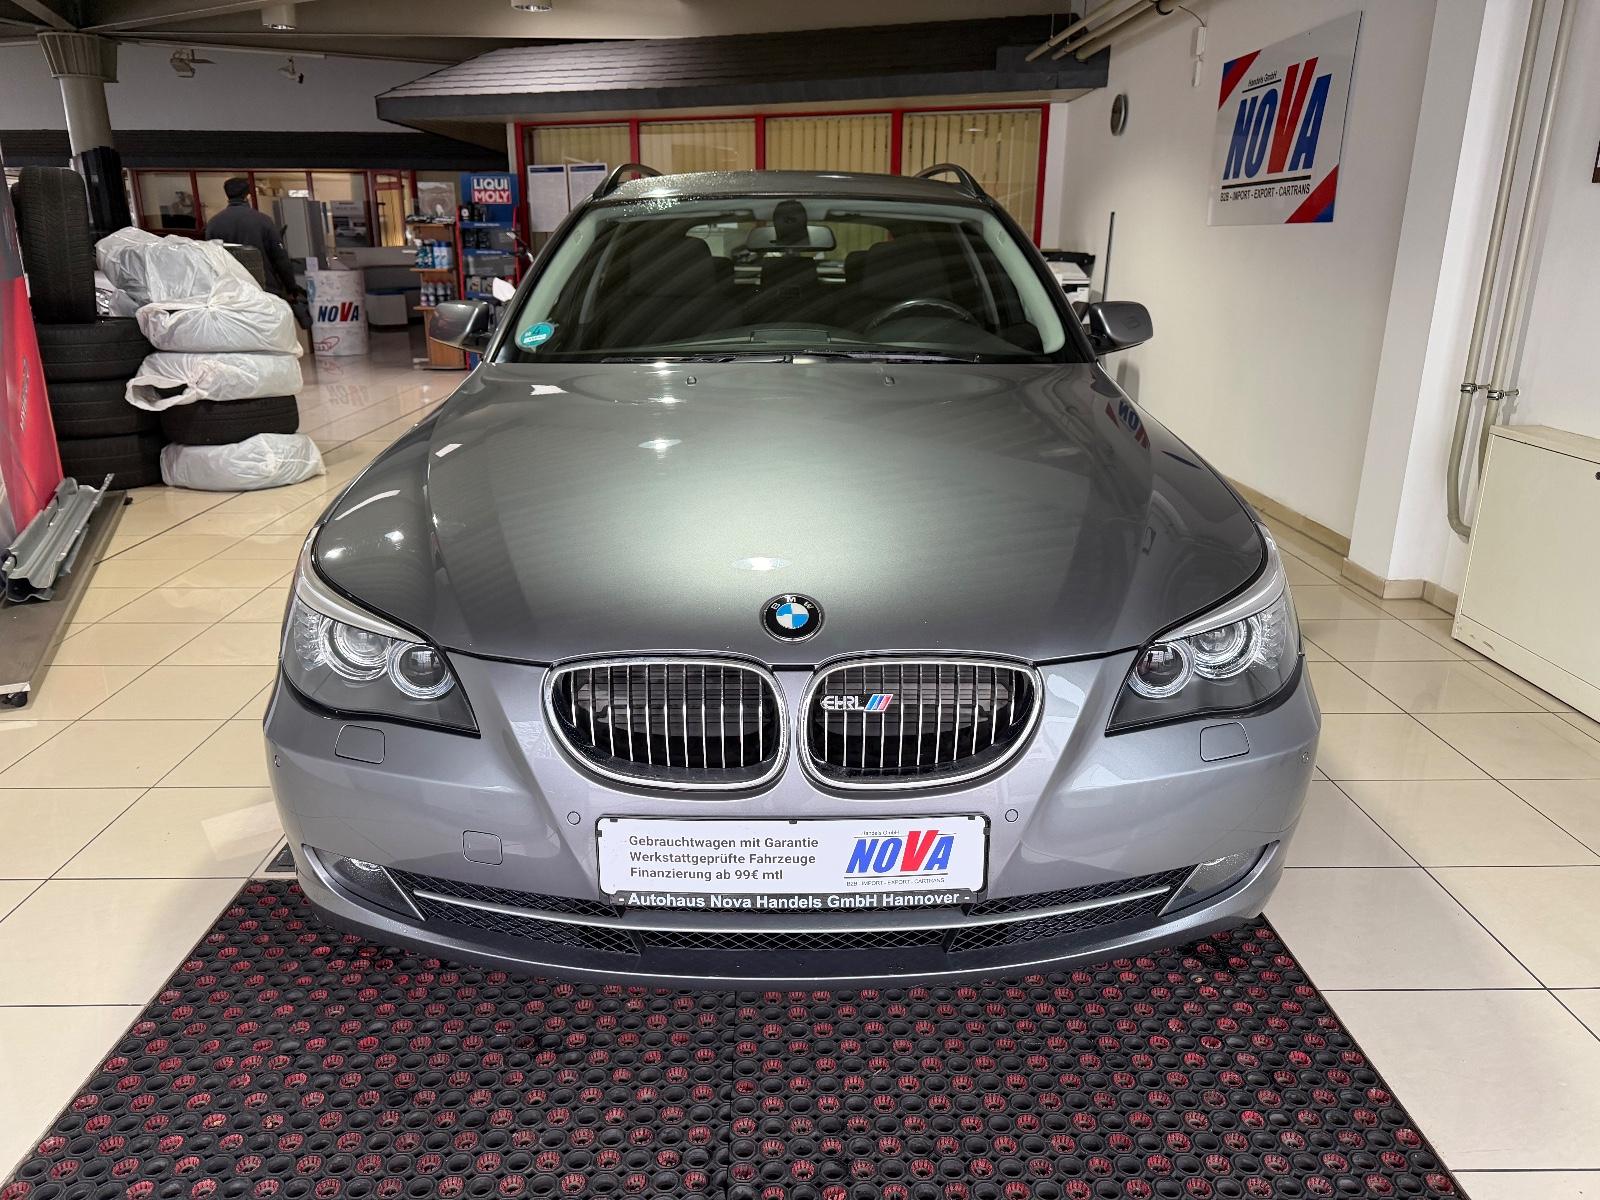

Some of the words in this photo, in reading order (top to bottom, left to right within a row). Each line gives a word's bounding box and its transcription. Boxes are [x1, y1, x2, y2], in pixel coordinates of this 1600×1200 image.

[1222, 56, 1333, 180] NOVA
[473, 178, 509, 190] LIQUI
[1231, 189, 1251, 201] IMPORT
[1253, 187, 1276, 199] EXPORT
[1278, 183, 1311, 197] CARTRANS
[474, 190, 510, 203] MOLY
[317, 301, 360, 322] NOVA
[770, 594, 815, 610] BMW
[628, 835, 736, 851] Gebrauchtwagen
[740, 837, 761, 848] mit
[764, 837, 819, 848] Garantie
[629, 851, 746, 866] Werkstattgeprüfte
[749, 853, 816, 867] Fahrzeuge
[845, 829, 955, 874] NOVA
[630, 867, 712, 882] Finanzierung
[715, 869, 731, 880] ab
[734, 869, 759, 880] 99€
[762, 869, 783, 880] mtl
[628, 892, 706, 907] Autohaus
[710, 894, 751, 908] Nova
[756, 895, 822, 909] Handels
[827, 893, 877, 908] GmbH
[883, 893, 960, 906] Hannover
